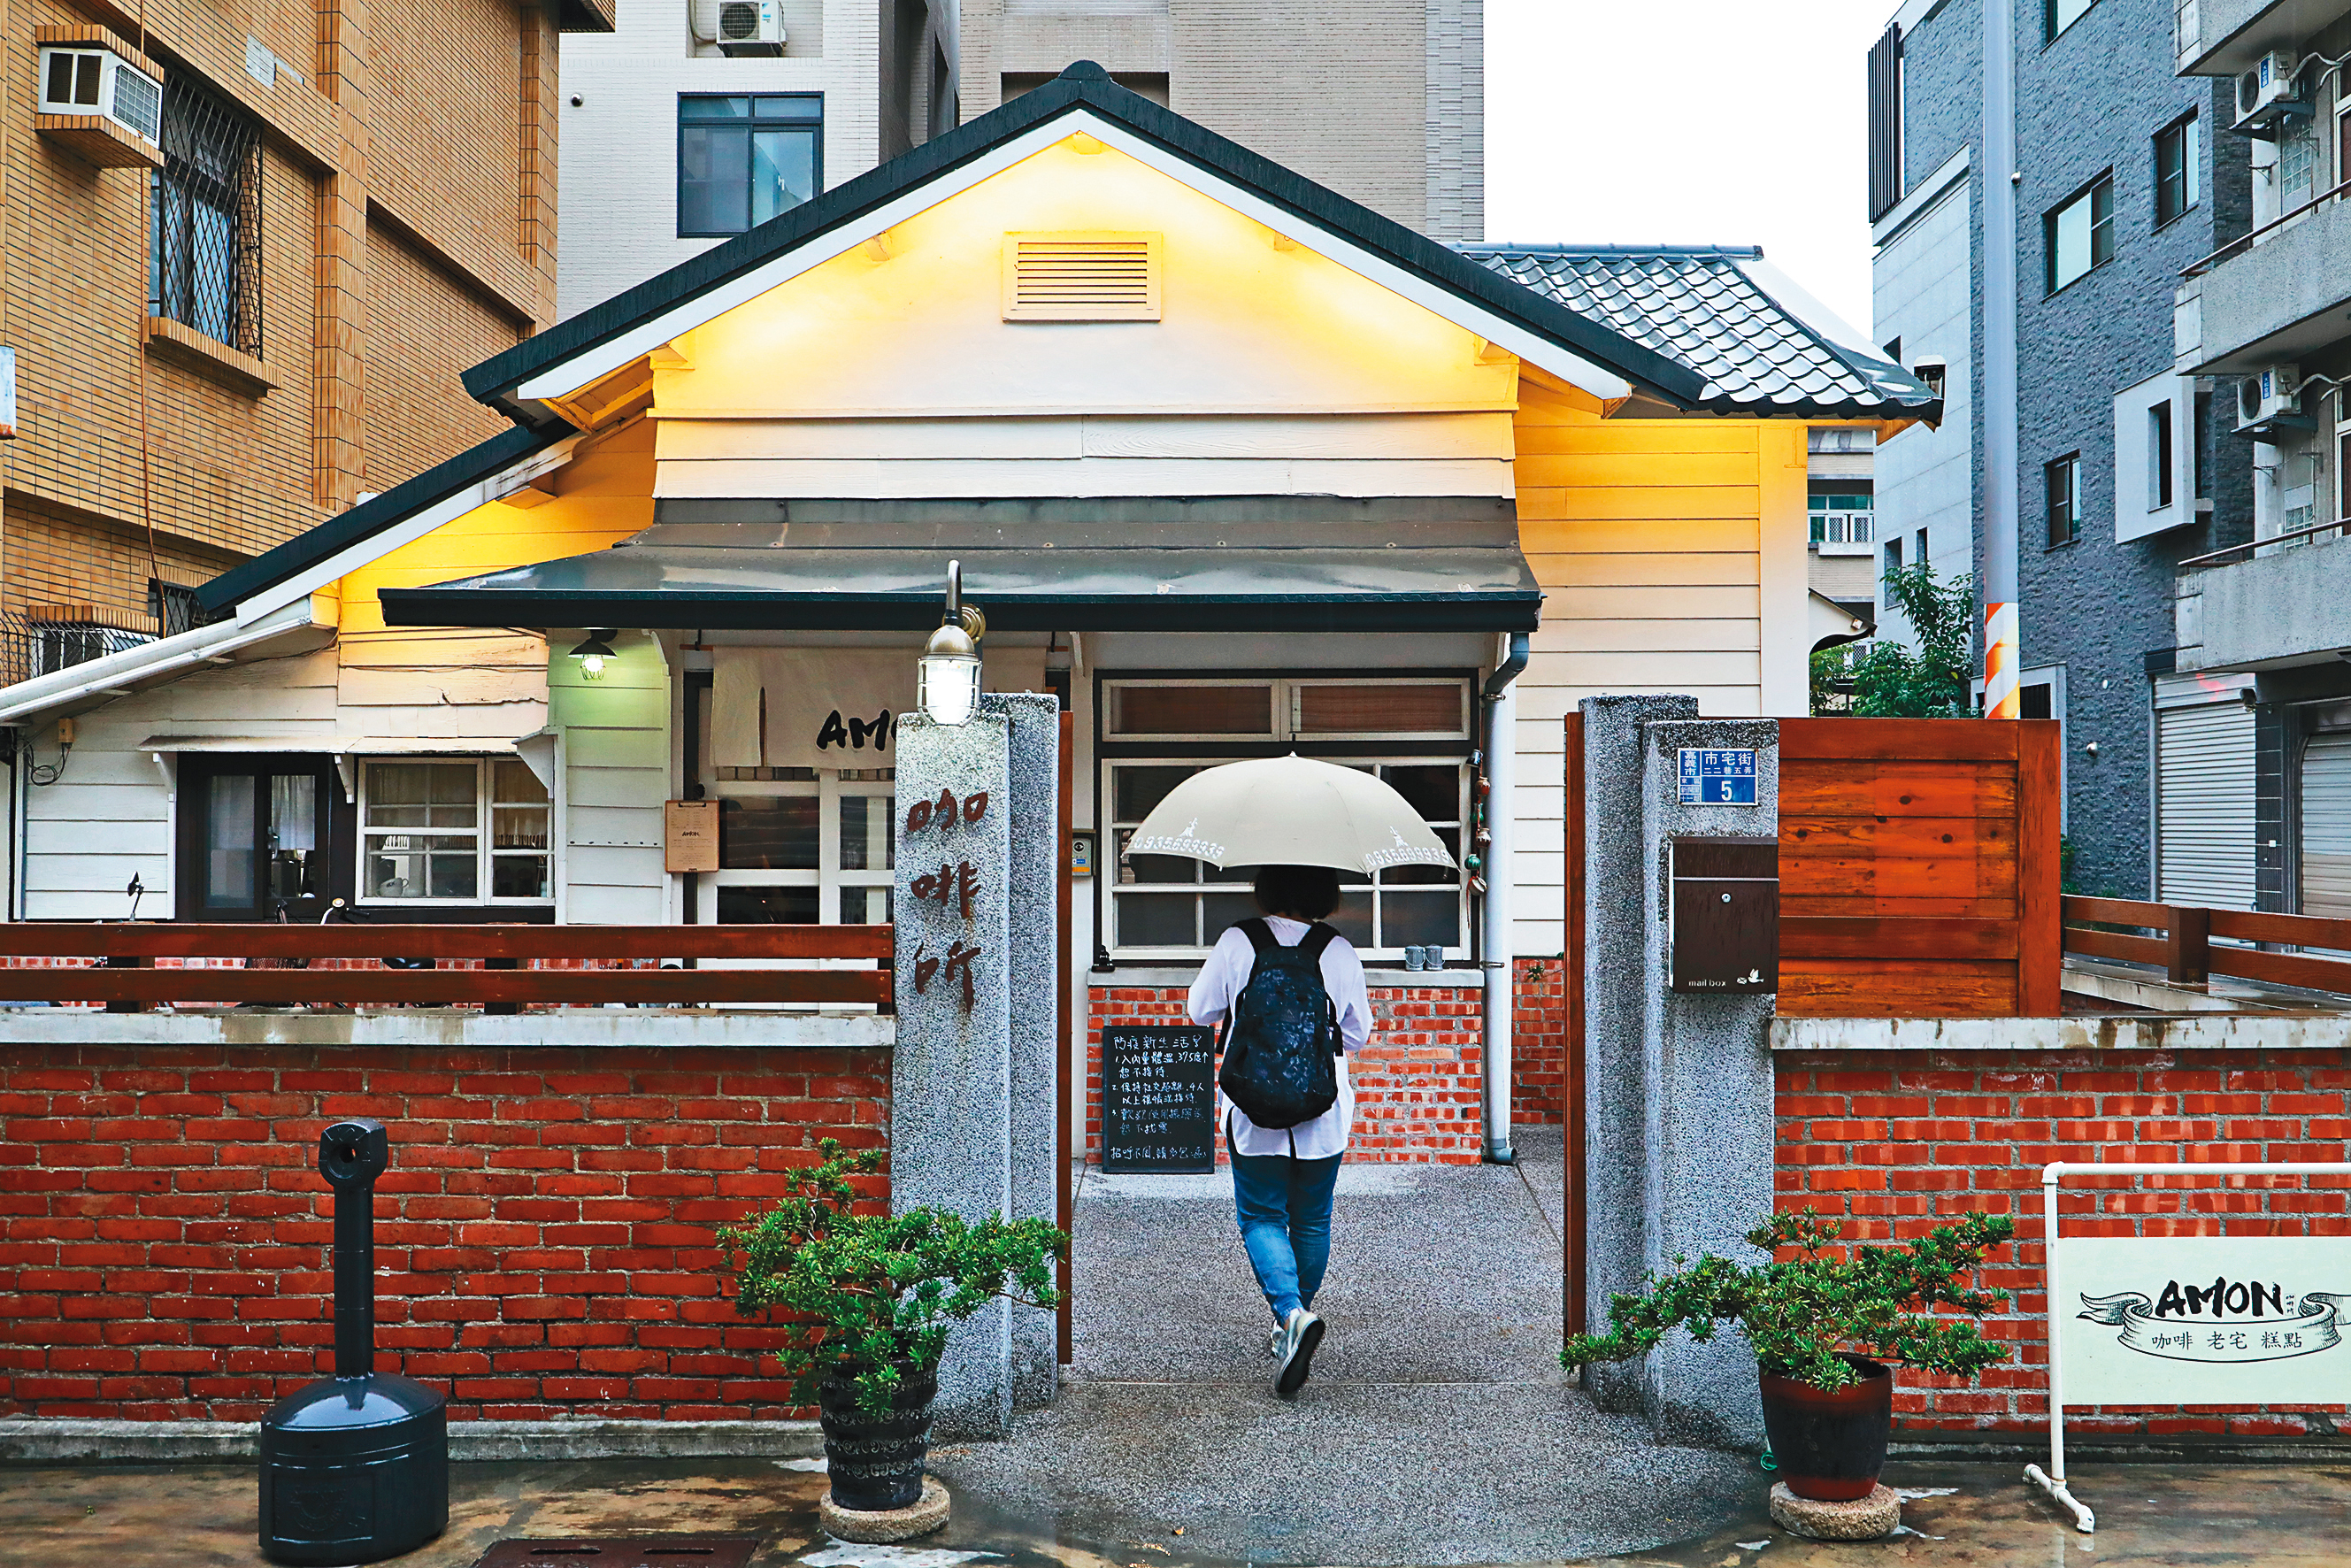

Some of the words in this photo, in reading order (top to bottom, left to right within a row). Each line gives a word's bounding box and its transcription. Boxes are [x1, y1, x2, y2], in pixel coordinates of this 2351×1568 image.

[816, 709, 897, 751] AM
[1704, 751, 1752, 766] 市宅街
[1721, 780, 1733, 801] 5
[2155, 1276, 2284, 1318] AMON
[2151, 1332, 2193, 1350] 咖啡
[2207, 1331, 2248, 1350] 老宅
[2261, 1332, 2303, 1349] 糕點
